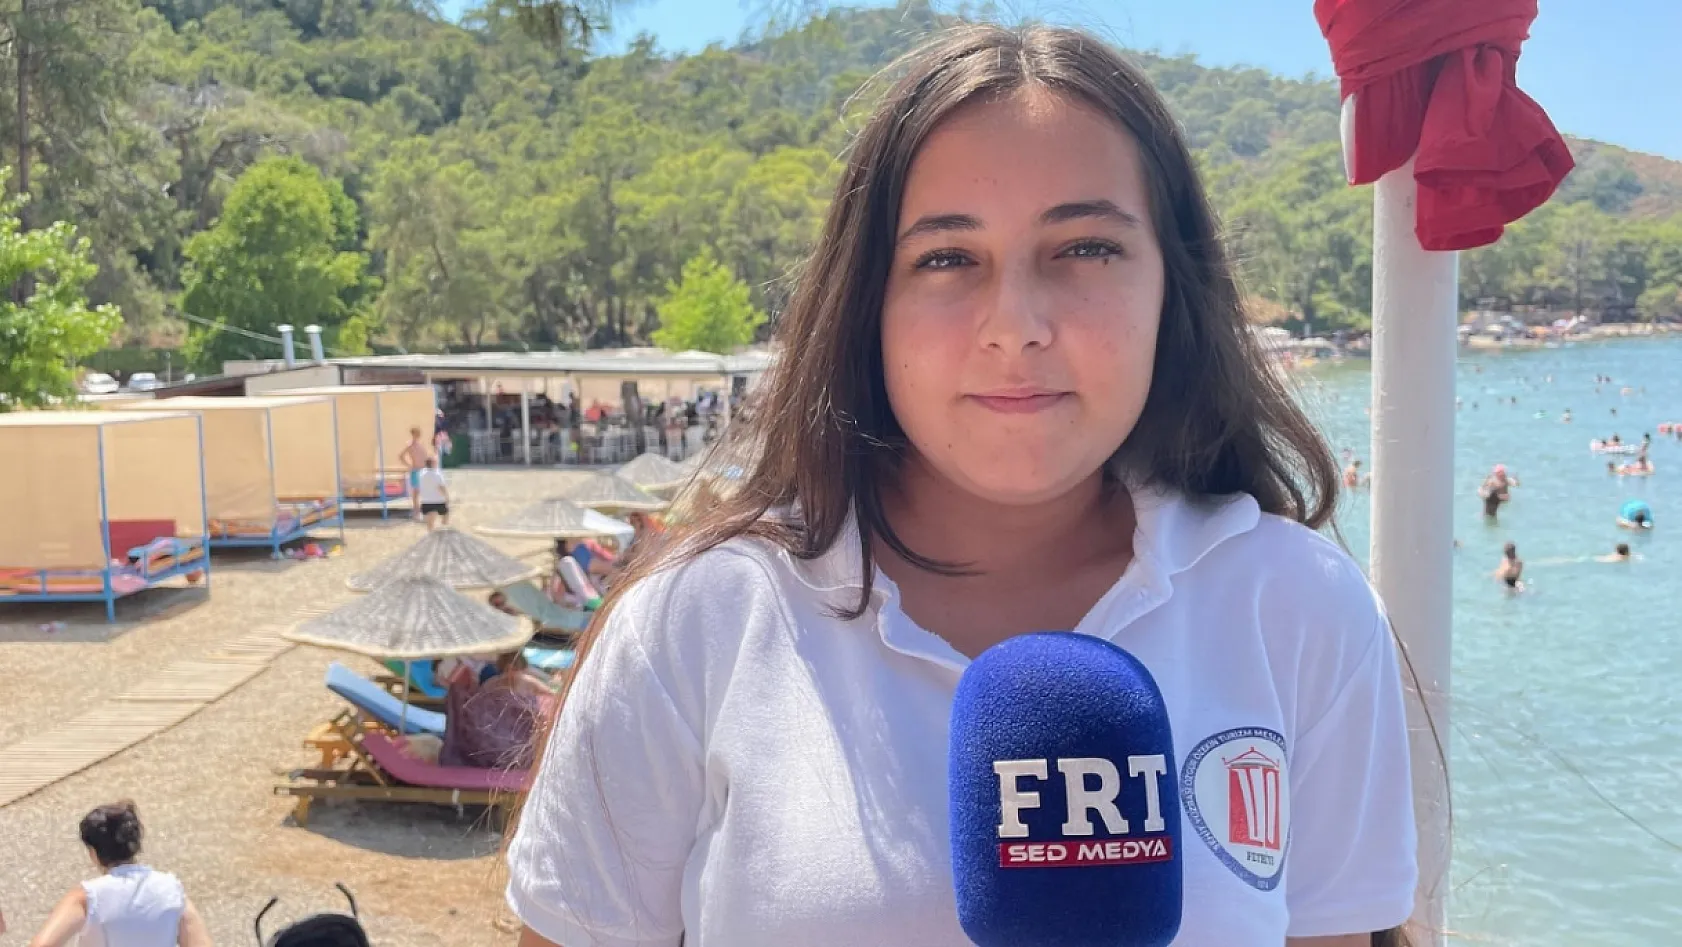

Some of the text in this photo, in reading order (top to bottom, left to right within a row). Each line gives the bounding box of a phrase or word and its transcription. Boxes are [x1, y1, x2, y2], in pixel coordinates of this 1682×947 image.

[993, 754, 1167, 838] FRT
[1008, 839, 1167, 862] SED MEDYA
